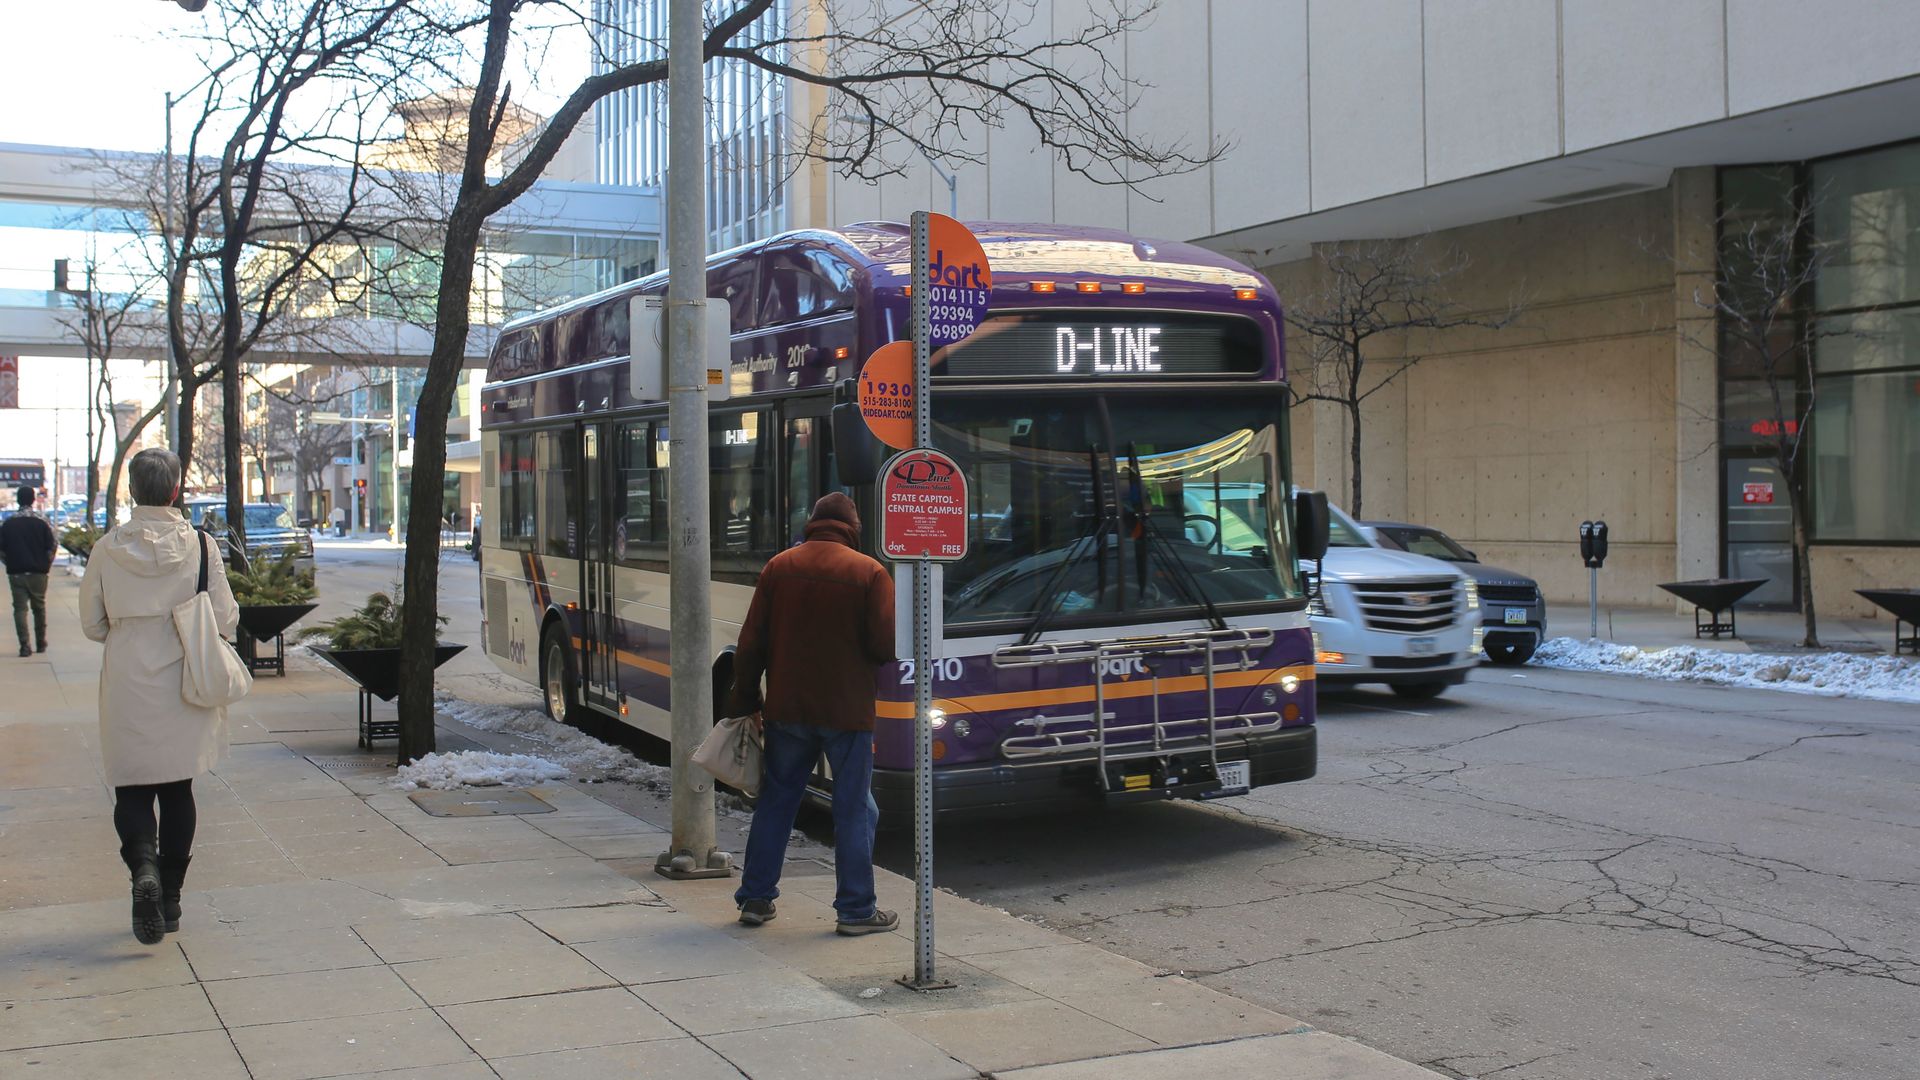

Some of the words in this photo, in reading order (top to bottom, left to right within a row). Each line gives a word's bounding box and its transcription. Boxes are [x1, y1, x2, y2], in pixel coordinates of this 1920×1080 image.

[929, 250, 984, 289] dart
[929, 305, 974, 321] 29394
[787, 344, 811, 368] 201
[1057, 327, 1161, 372] D-LINE
[749, 353, 778, 376] Authority
[867, 381, 911, 396] 1930
[863, 397, 912, 408] 515-283-8100
[863, 407, 913, 419] RIDEDART.COM
[891, 493, 917, 503] STATE
[918, 494, 954, 504] CAPITOL
[887, 504, 926, 514] CENTRAL
[927, 506, 963, 515] CAMPUS
[888, 541, 907, 552] dart
[942, 544, 961, 554] FREE
[899, 658, 963, 685] 210
